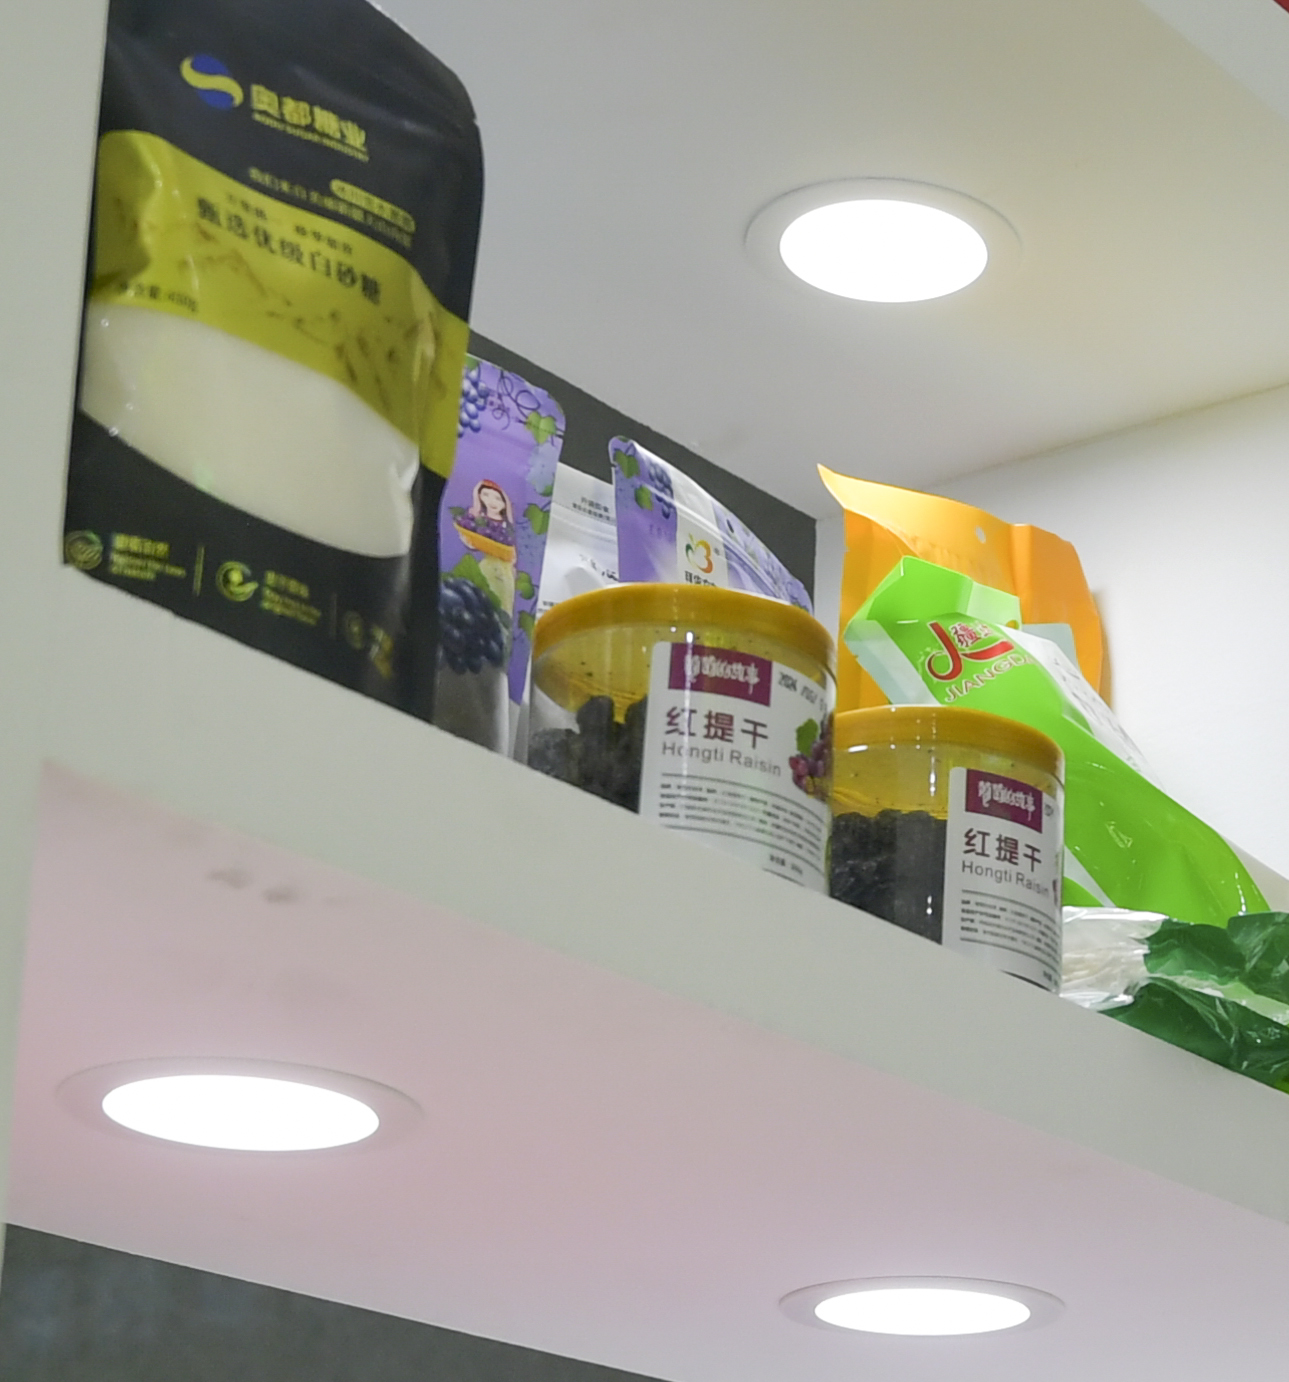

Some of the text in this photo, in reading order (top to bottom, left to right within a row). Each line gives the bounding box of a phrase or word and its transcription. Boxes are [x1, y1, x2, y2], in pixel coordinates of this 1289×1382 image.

[665, 705, 769, 750] 红提干
[662, 740, 782, 778] Hongti Raisin
[963, 827, 1042, 873] 红提干
[961, 859, 1049, 897] Hongti Raisin
